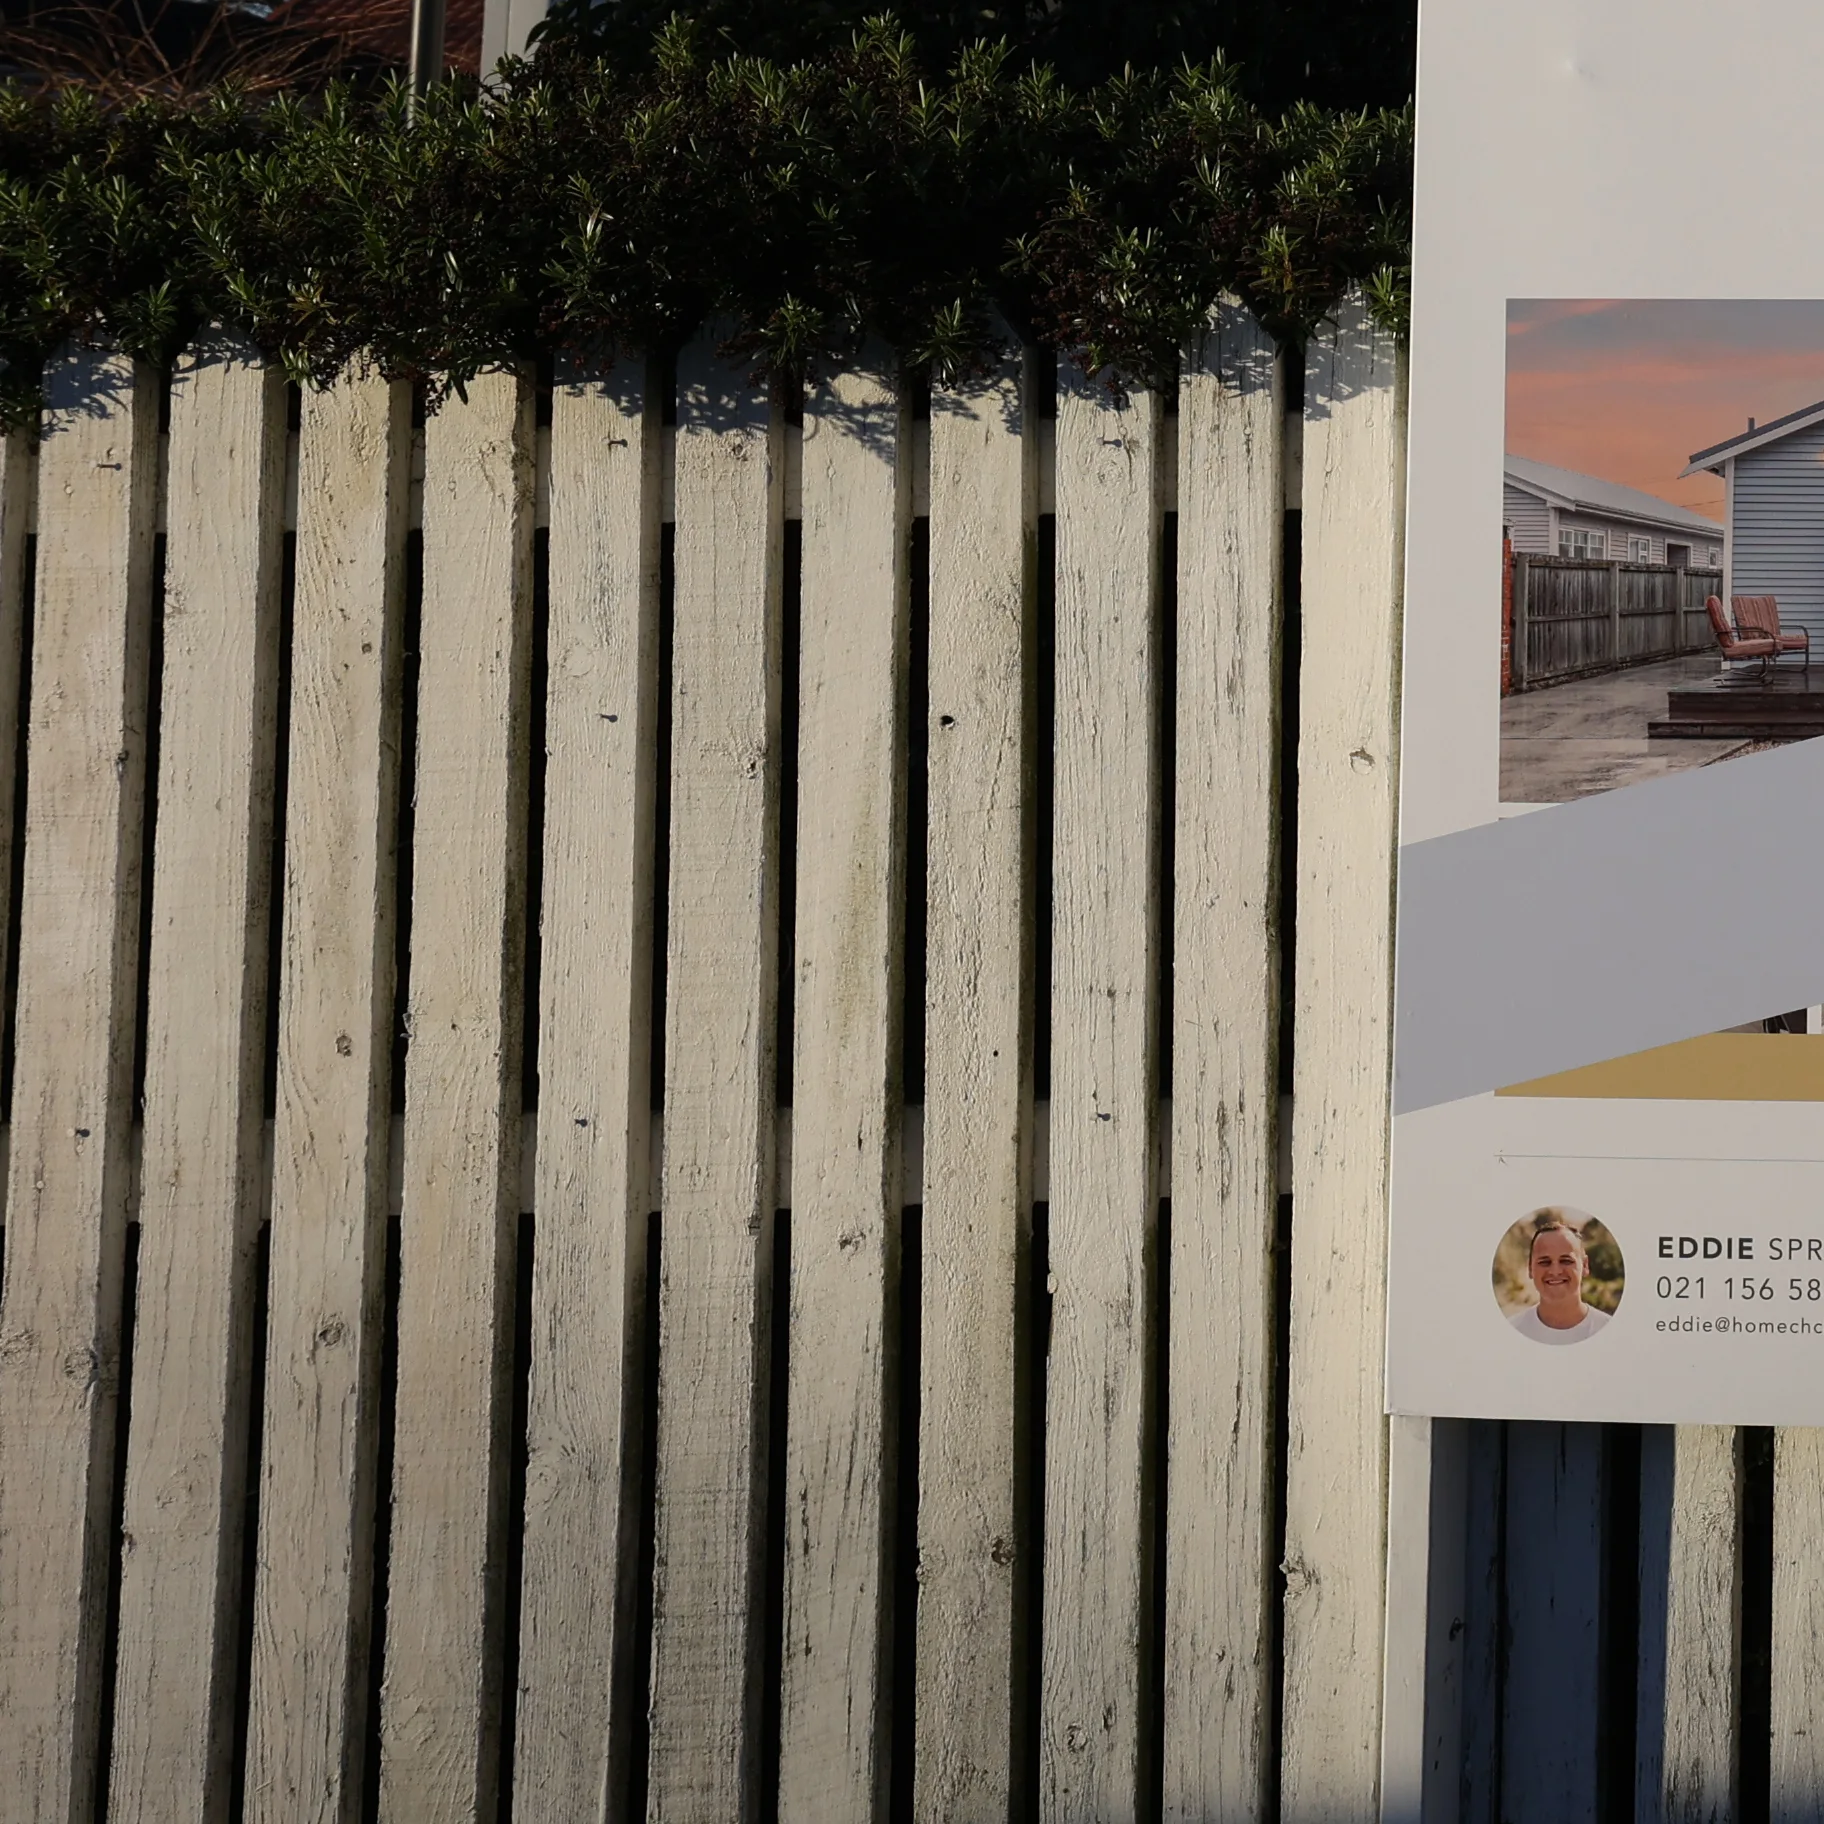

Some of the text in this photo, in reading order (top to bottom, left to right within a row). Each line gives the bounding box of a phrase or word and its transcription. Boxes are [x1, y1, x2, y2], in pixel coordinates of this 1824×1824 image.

[1658, 1236, 1754, 1260] EDDIE
[1656, 1276, 1705, 1300] 021
[1724, 1277, 1774, 1301] 156
